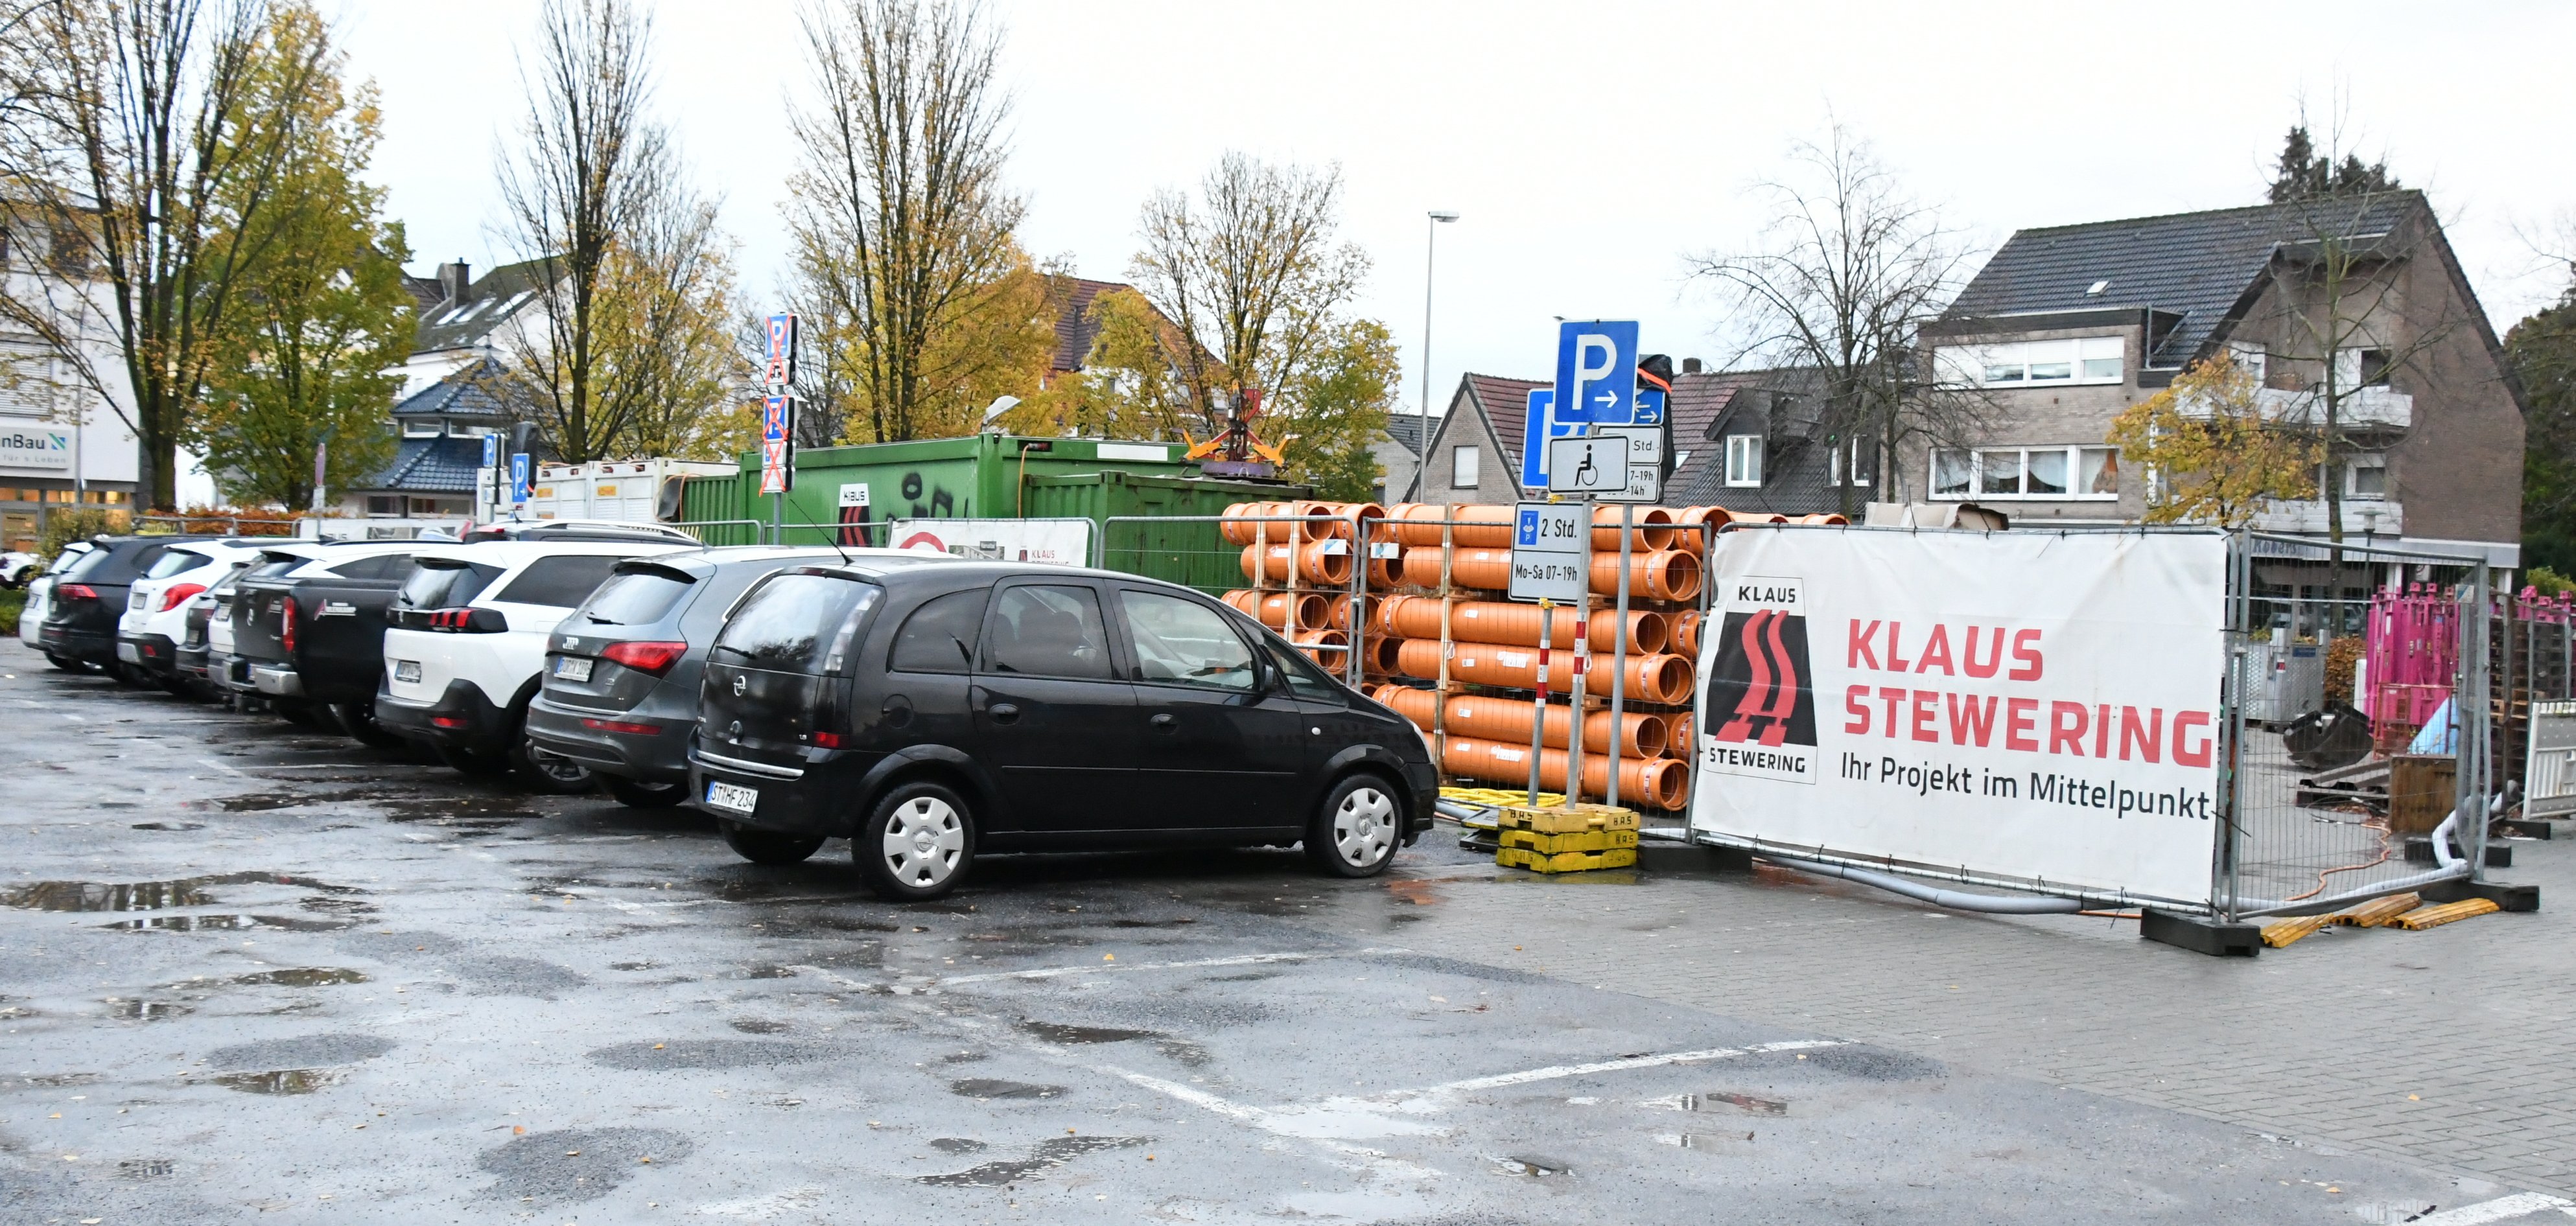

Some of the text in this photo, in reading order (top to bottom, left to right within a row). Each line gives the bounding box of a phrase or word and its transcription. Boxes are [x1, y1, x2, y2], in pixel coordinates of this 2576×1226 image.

[1572, 334, 1617, 410] P
[1633, 440, 1655, 451] Std.
[515, 461, 525, 496] P
[1541, 518, 1577, 538] 2 Std.
[1031, 549, 1055, 559] KLAUS
[1516, 564, 1577, 581] Mo-Sa 07-19h
[1739, 586, 1796, 603] KLAUS
[1847, 619, 2043, 682] KLAUS
[1845, 684, 2212, 768] STEWERING
[1709, 747, 1806, 773] STEWERING
[711, 785, 756, 809] ST HF 234
[1842, 752, 2210, 820] Ihr Projekt im Mittelpunkt
